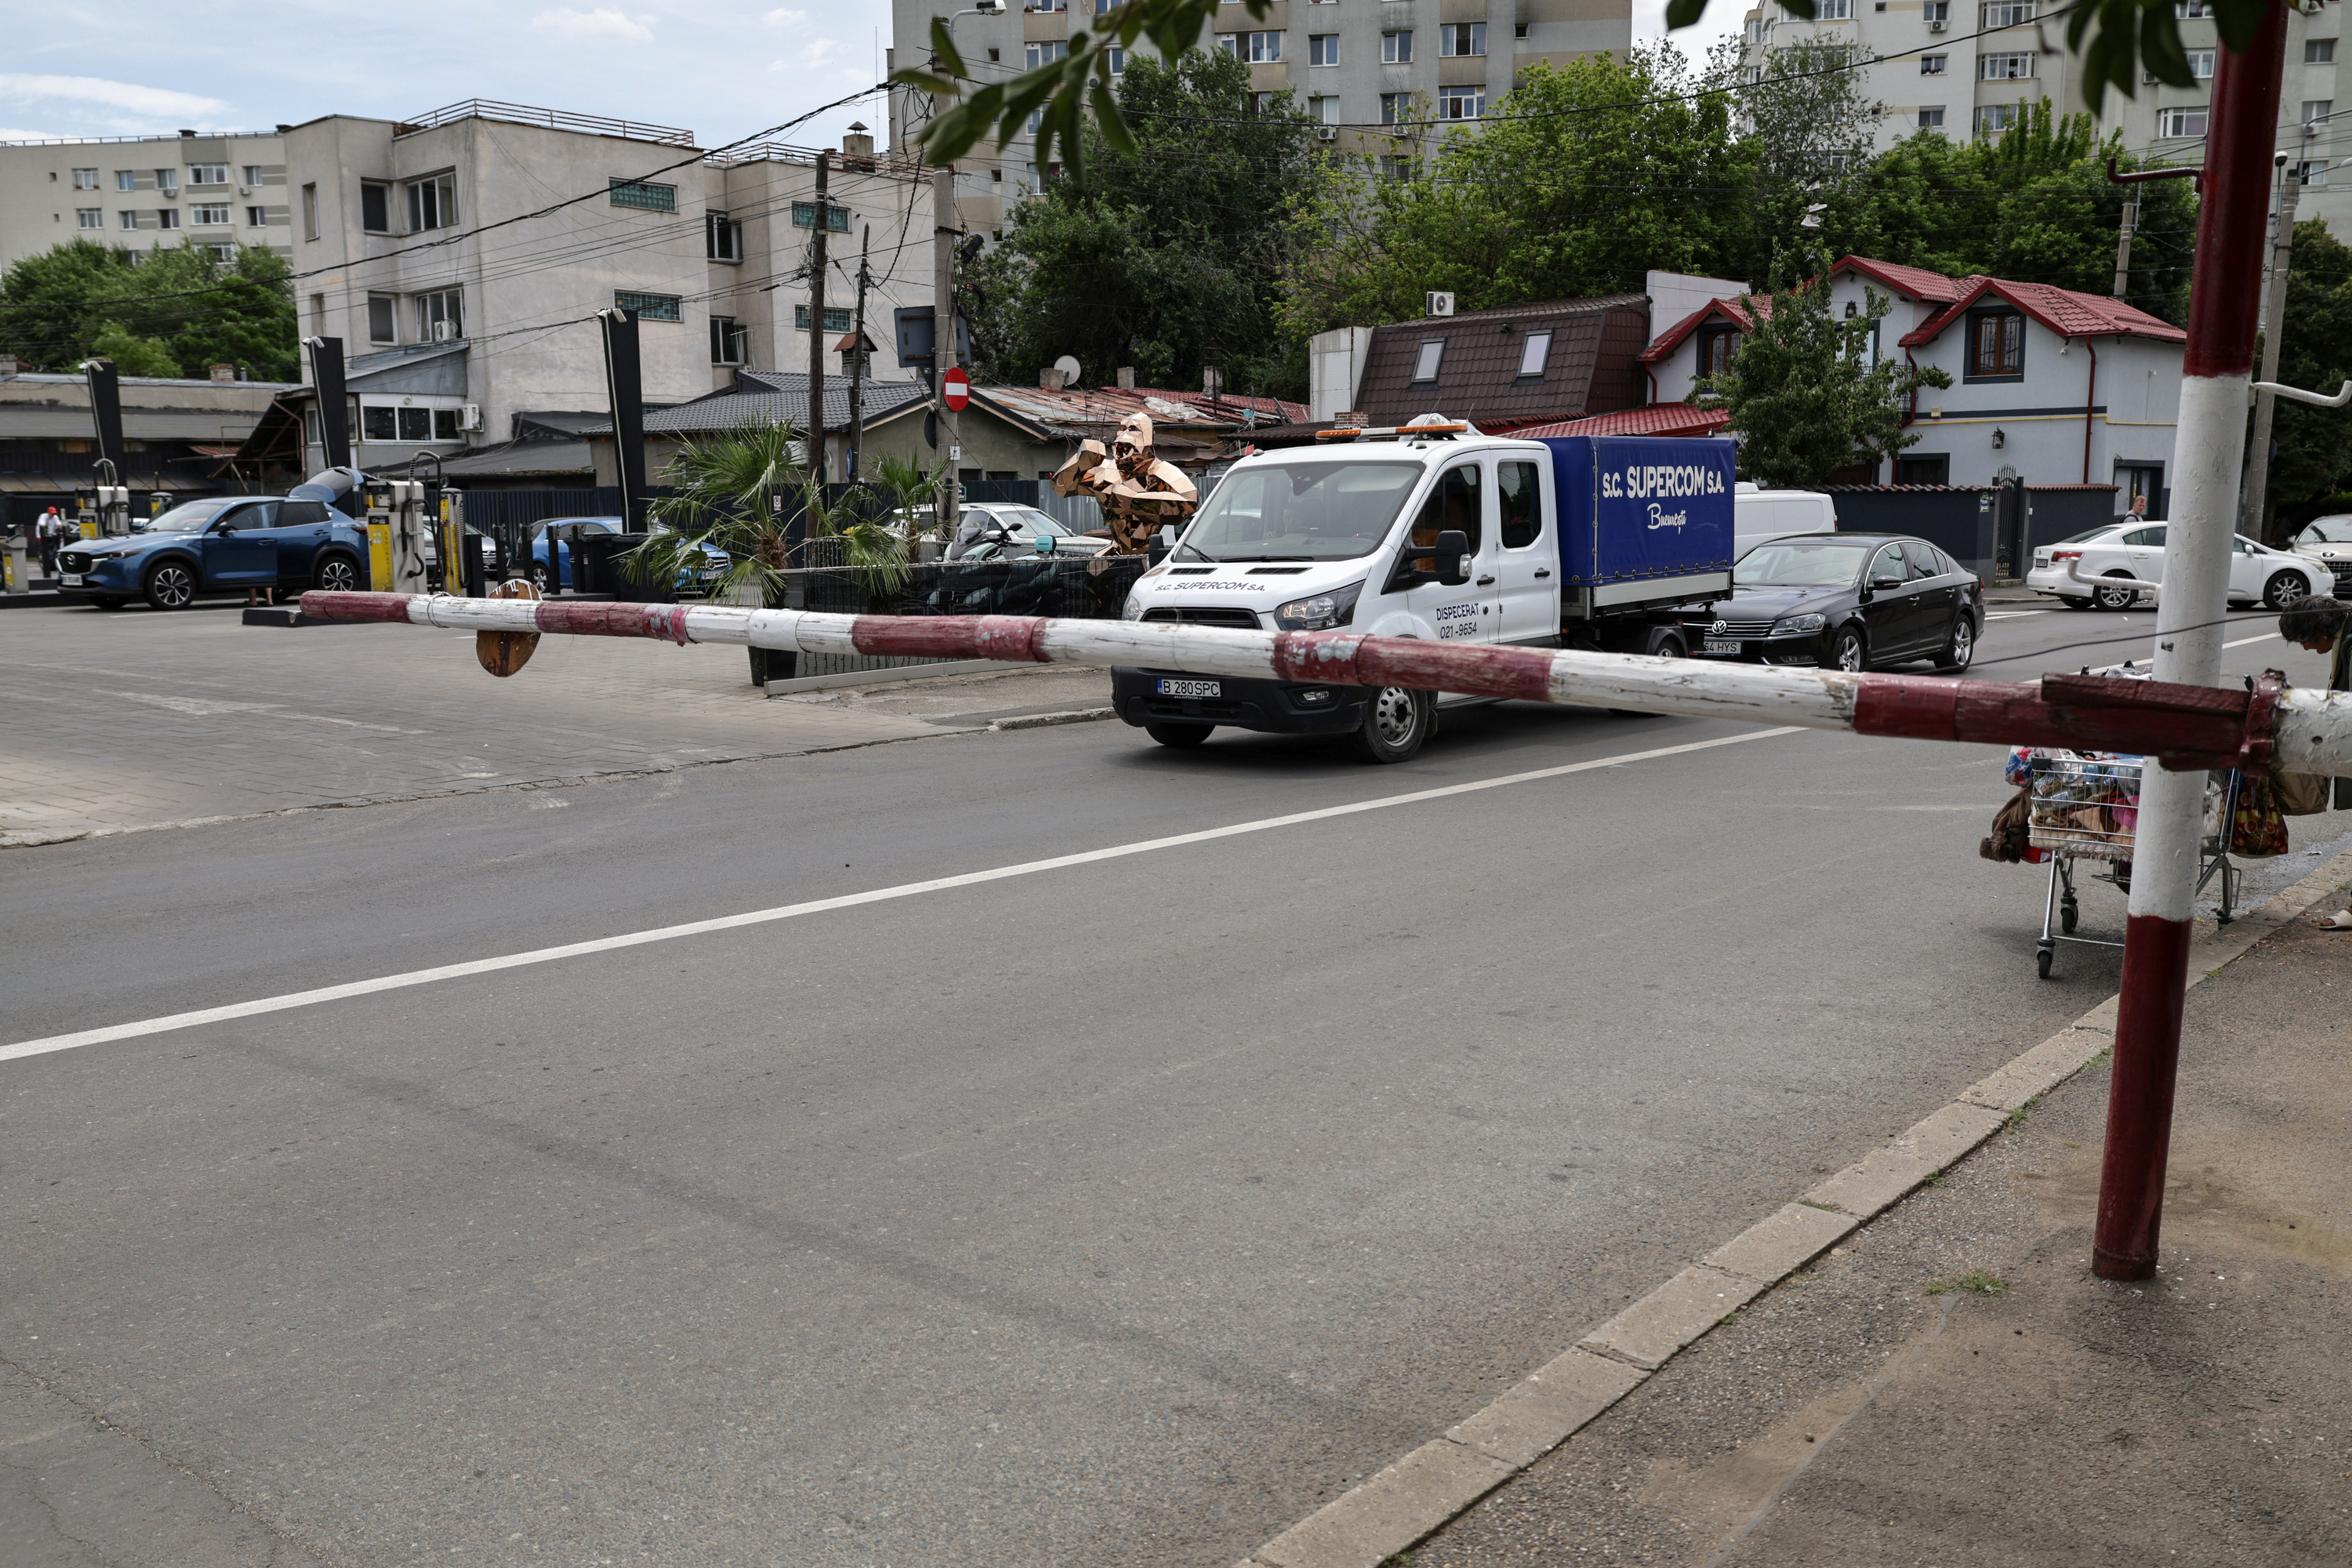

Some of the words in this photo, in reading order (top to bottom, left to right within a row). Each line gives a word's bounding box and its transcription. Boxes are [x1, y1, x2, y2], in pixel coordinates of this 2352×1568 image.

[1602, 472, 1623, 498] S.C.
[1627, 465, 1705, 499] SUPERCOM
[1707, 470, 1725, 494] S.A.
[1174, 582, 1249, 590] SUPERCOM
[1436, 603, 1479, 621] DISPECERAT
[1718, 642, 1737, 652] HYS
[1163, 681, 1171, 693] B
